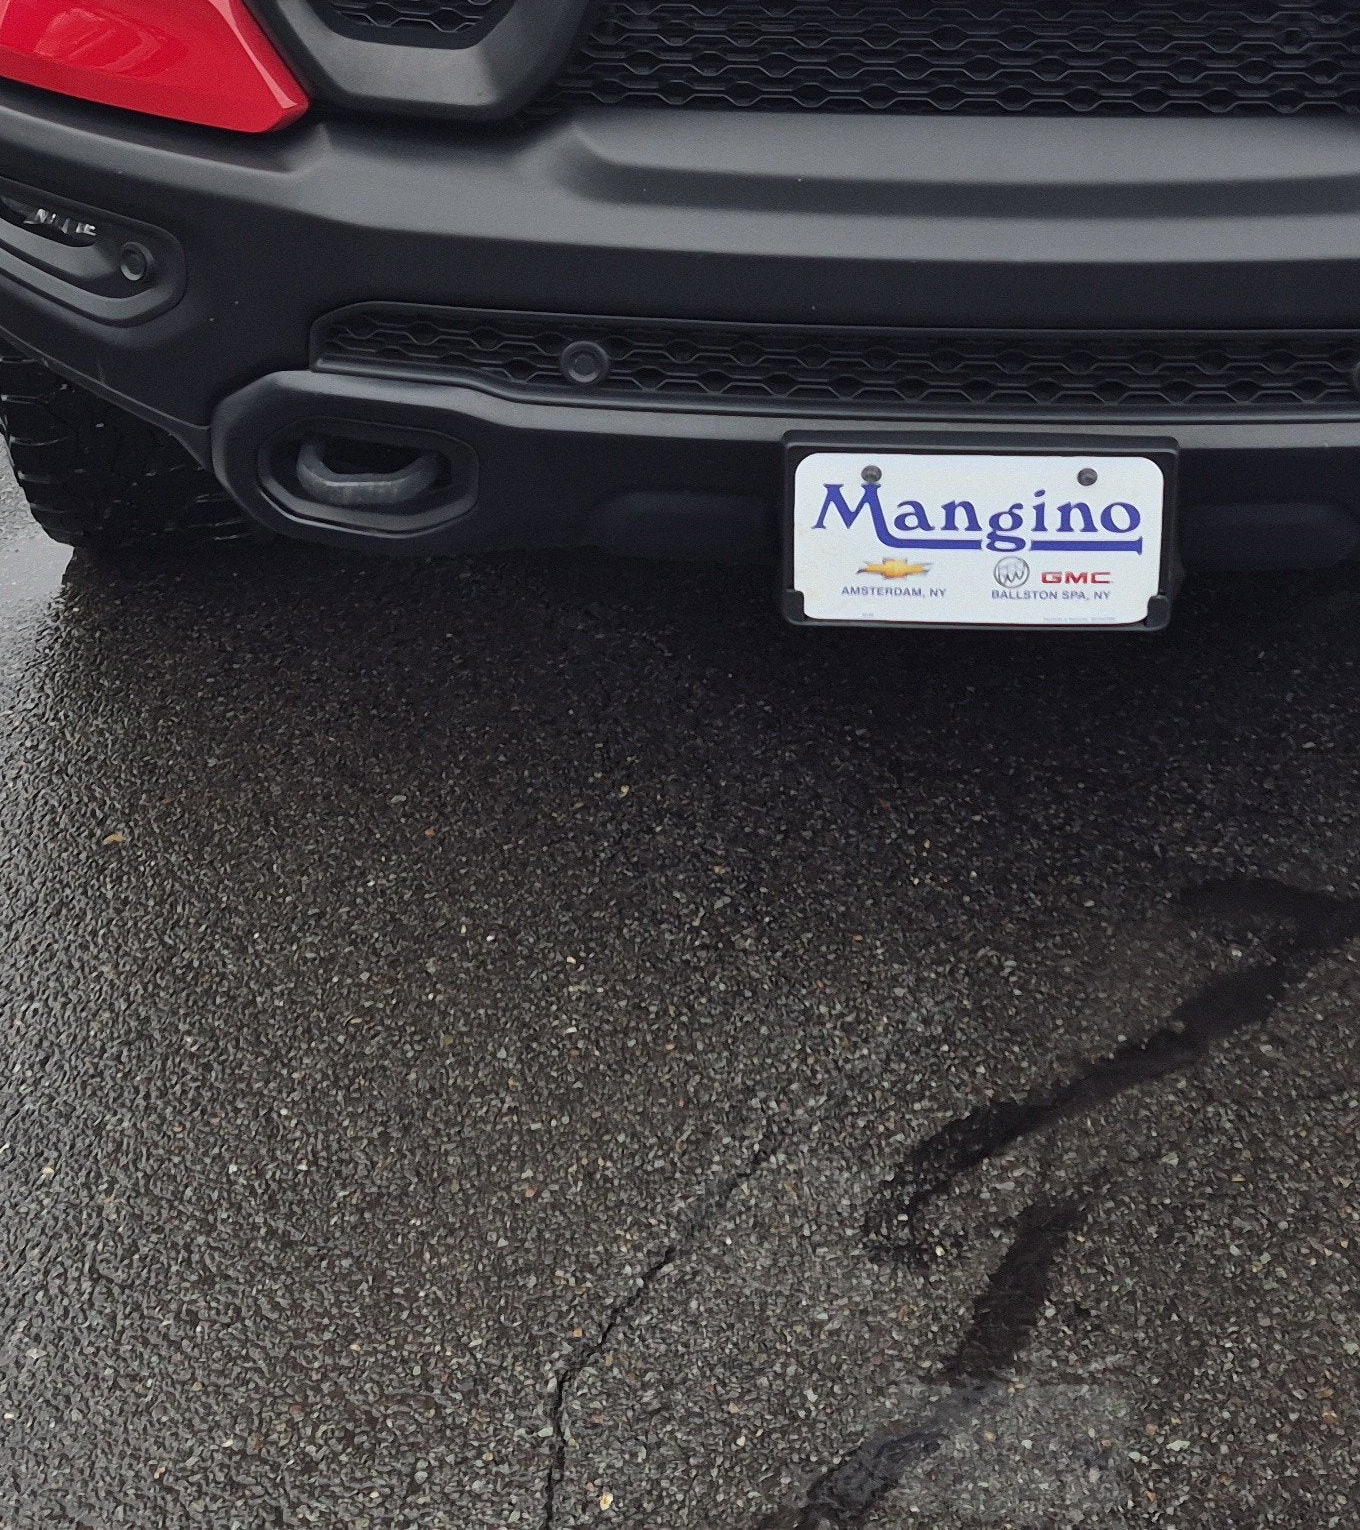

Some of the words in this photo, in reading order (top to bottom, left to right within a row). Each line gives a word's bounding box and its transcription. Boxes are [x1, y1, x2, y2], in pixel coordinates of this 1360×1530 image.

[812, 483, 1142, 555] Mangino
[1041, 571, 1111, 584] GMC
[841, 586, 926, 598] AMSTERDAM,
[929, 587, 947, 598] NY
[991, 589, 1058, 601] BALLSTON
[1061, 590, 1089, 601] SPA,
[1093, 590, 1112, 600] NY
